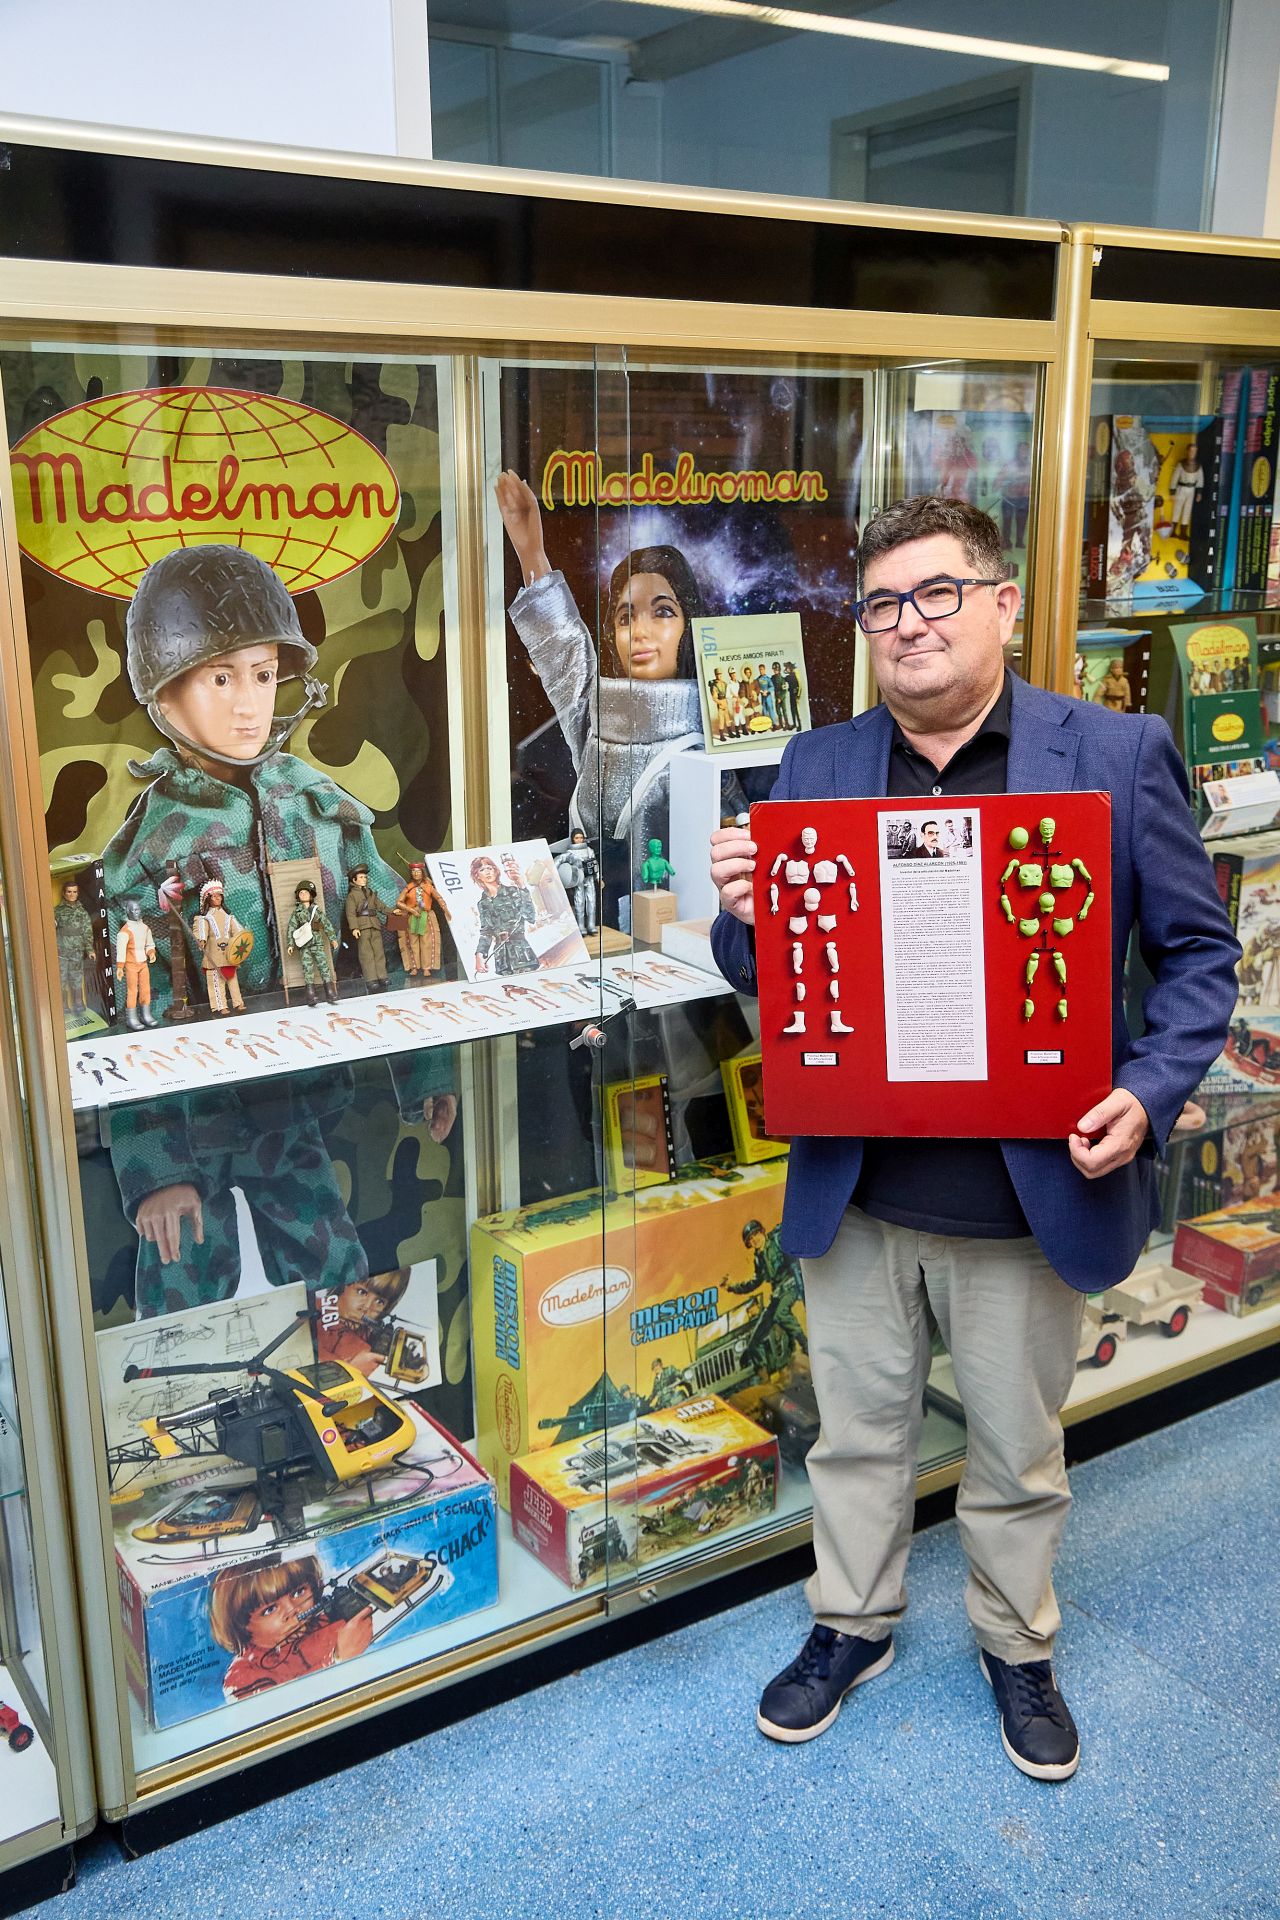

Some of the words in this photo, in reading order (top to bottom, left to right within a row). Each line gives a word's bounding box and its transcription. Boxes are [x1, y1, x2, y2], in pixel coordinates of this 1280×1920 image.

[10, 453, 397, 524] Madelman
[542, 450, 828, 511] Madelwoman
[701, 626, 718, 660] 1971
[720, 654, 742, 662] NUEVOS
[743, 652, 764, 660] AMIGOS
[438, 861, 464, 895] 1977
[96, 868, 116, 1017] MADELMAN
[661, 1077, 677, 1178] MADELMAN
[322, 1294, 340, 1331] 1975
[544, 1280, 632, 1313] Madelman
[676, 1399, 716, 1420] JEEP
[523, 1483, 553, 1523] JEEP
[158, 1657, 203, 1679] MADELMAN
[175, 1655, 190, 1667] vivir
[191, 1649, 206, 1659] con
[159, 1673, 185, 1687] nuevas
[159, 1687, 169, 1696] en
[170, 1683, 178, 1691] el
